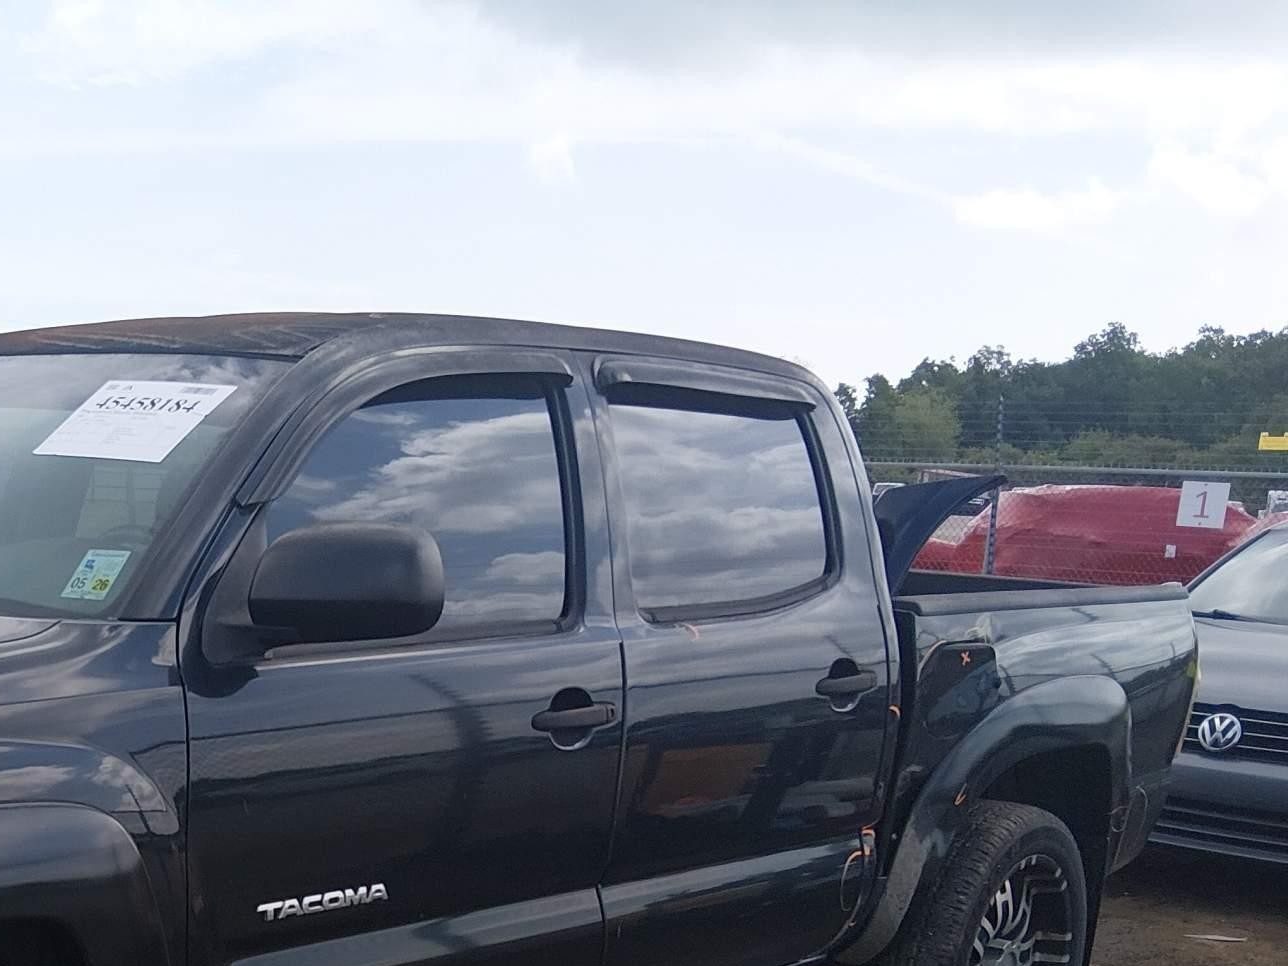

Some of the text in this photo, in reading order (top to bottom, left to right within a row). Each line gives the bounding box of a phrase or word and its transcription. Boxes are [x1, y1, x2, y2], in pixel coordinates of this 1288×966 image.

[95, 396, 201, 413] 45458184
[1192, 491, 1209, 518] 1
[70, 576, 110, 591] 05 26
[256, 883, 389, 921] TACOMA
